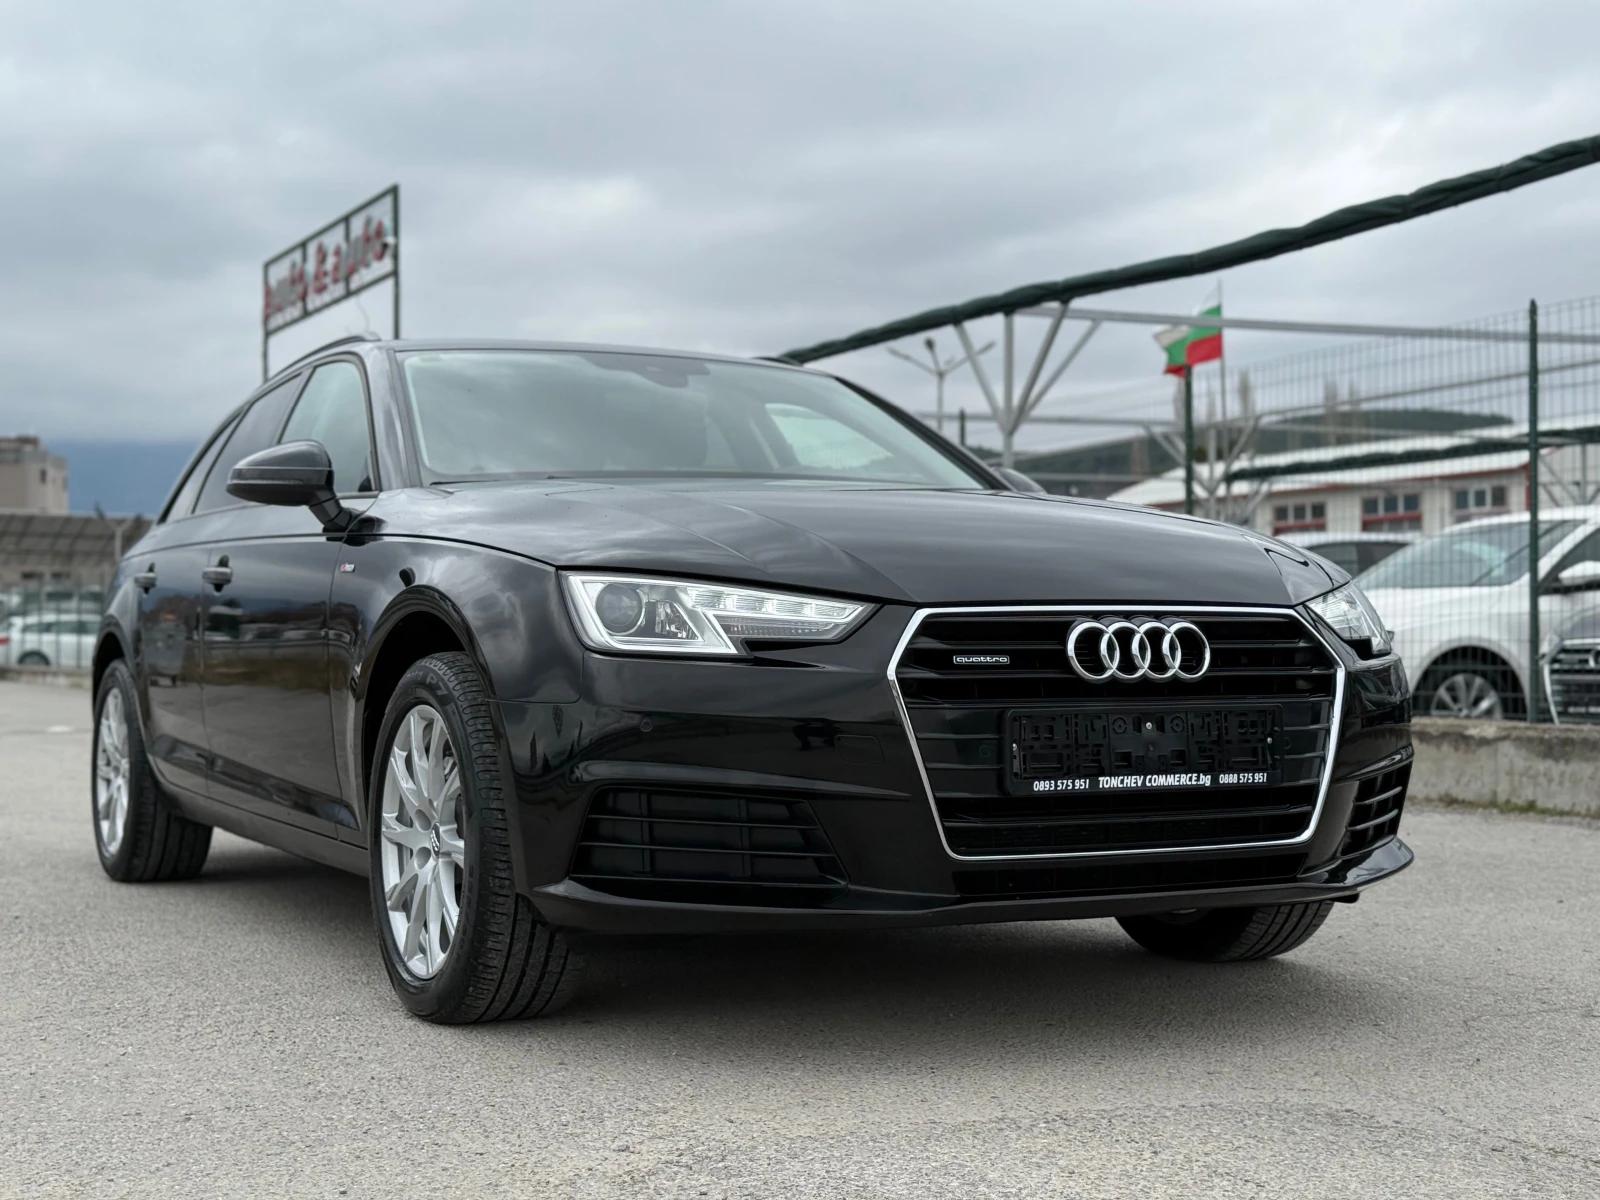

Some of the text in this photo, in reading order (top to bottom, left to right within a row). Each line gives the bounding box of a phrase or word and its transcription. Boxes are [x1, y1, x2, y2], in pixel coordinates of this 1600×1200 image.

[1033, 772, 1268, 792] 0893 575 951 TONCHEV COMMERCE.bg 0888 575 951
